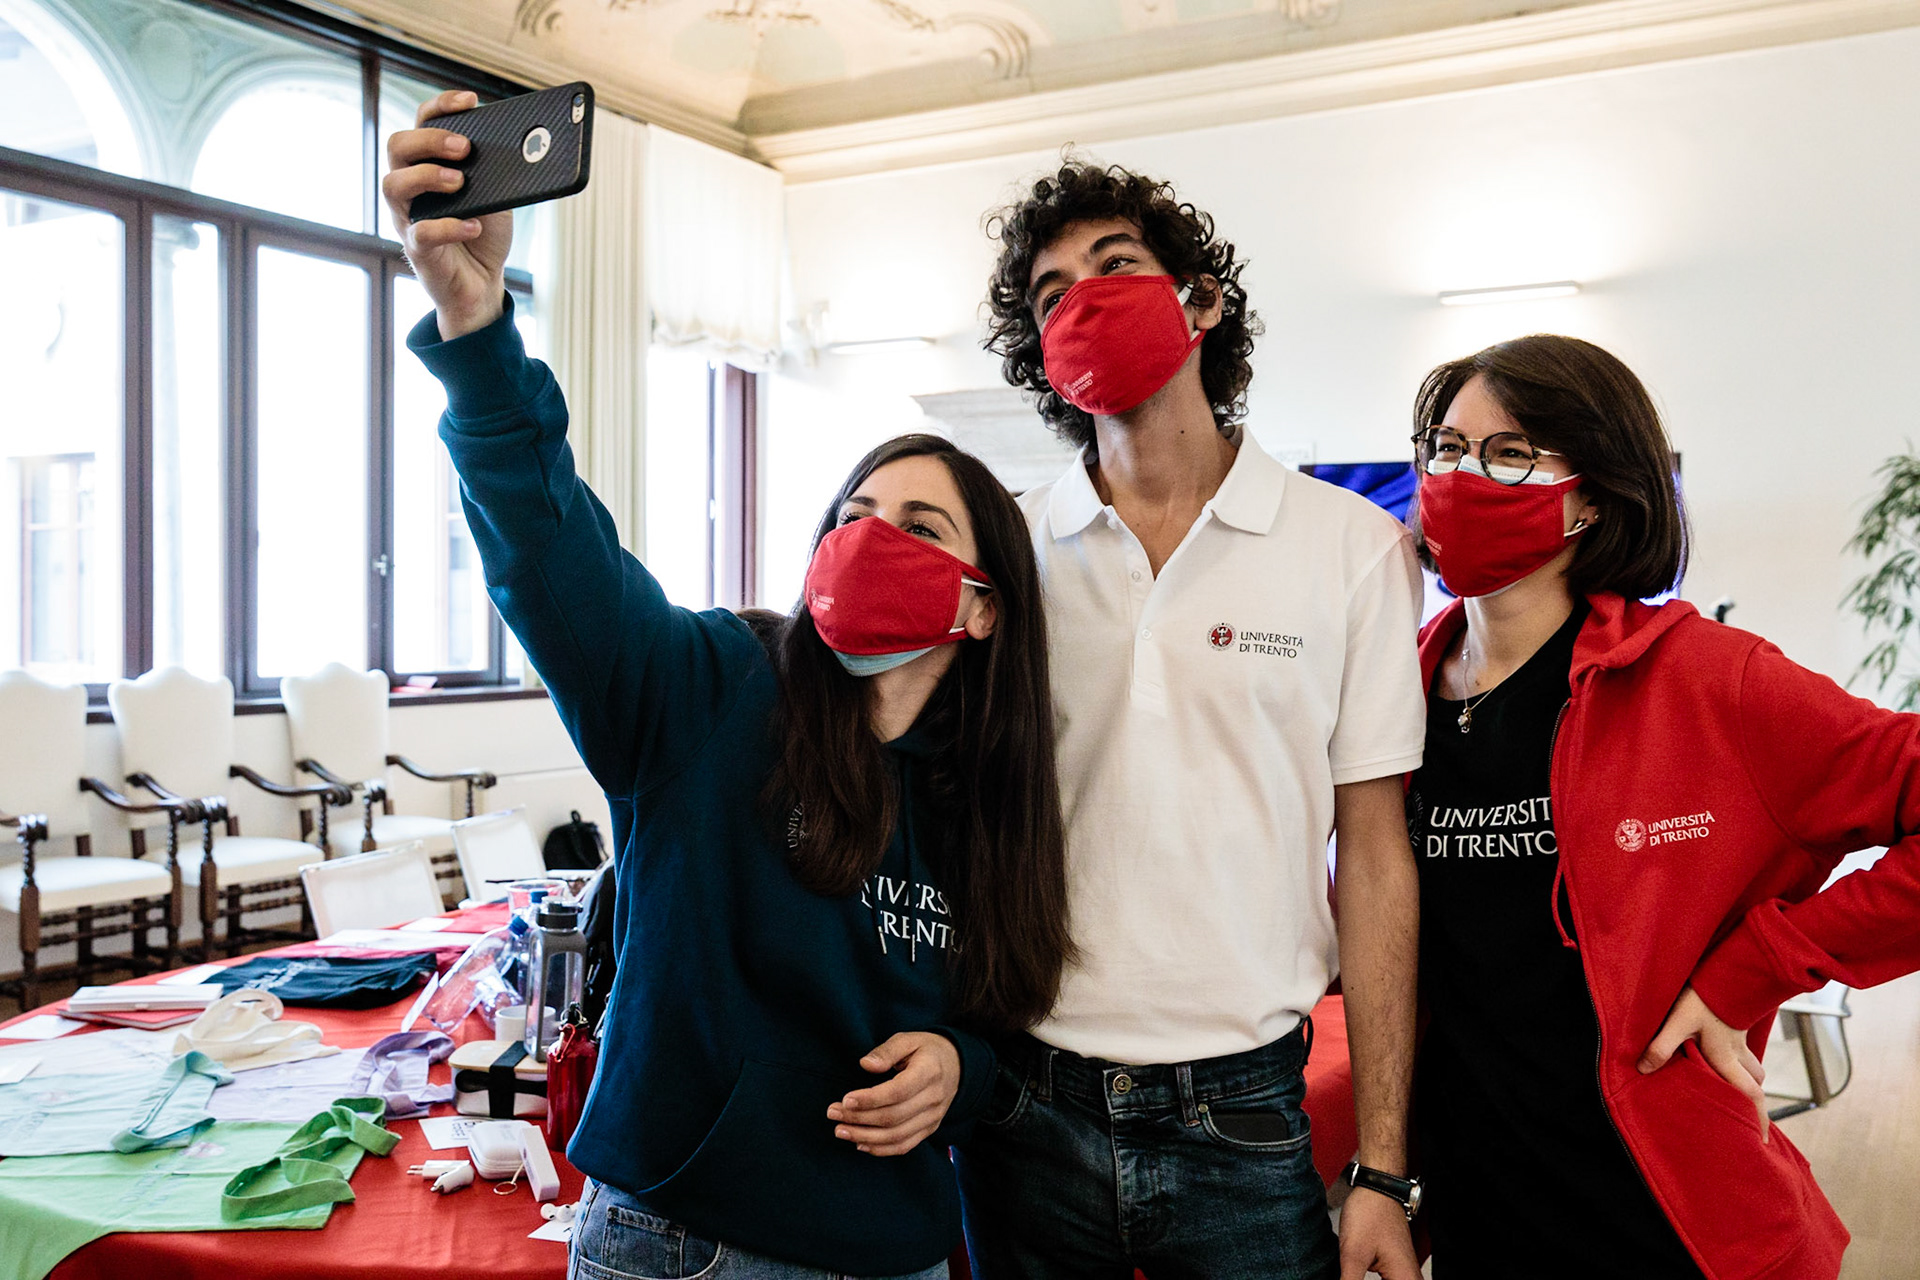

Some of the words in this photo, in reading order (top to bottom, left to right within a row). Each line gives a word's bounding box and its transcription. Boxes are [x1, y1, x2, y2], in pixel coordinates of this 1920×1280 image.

[1239, 643, 1251, 652] DI
[1253, 644, 1297, 659] TRENTO
[1430, 797, 1551, 828] UNIVERSIT
[1648, 810, 1715, 834] UNIVERSITÀ
[1427, 835, 1448, 858] DI
[1454, 830, 1558, 858] TRENTO
[1649, 835, 1660, 847] DI
[1661, 826, 1710, 843] TRENTO
